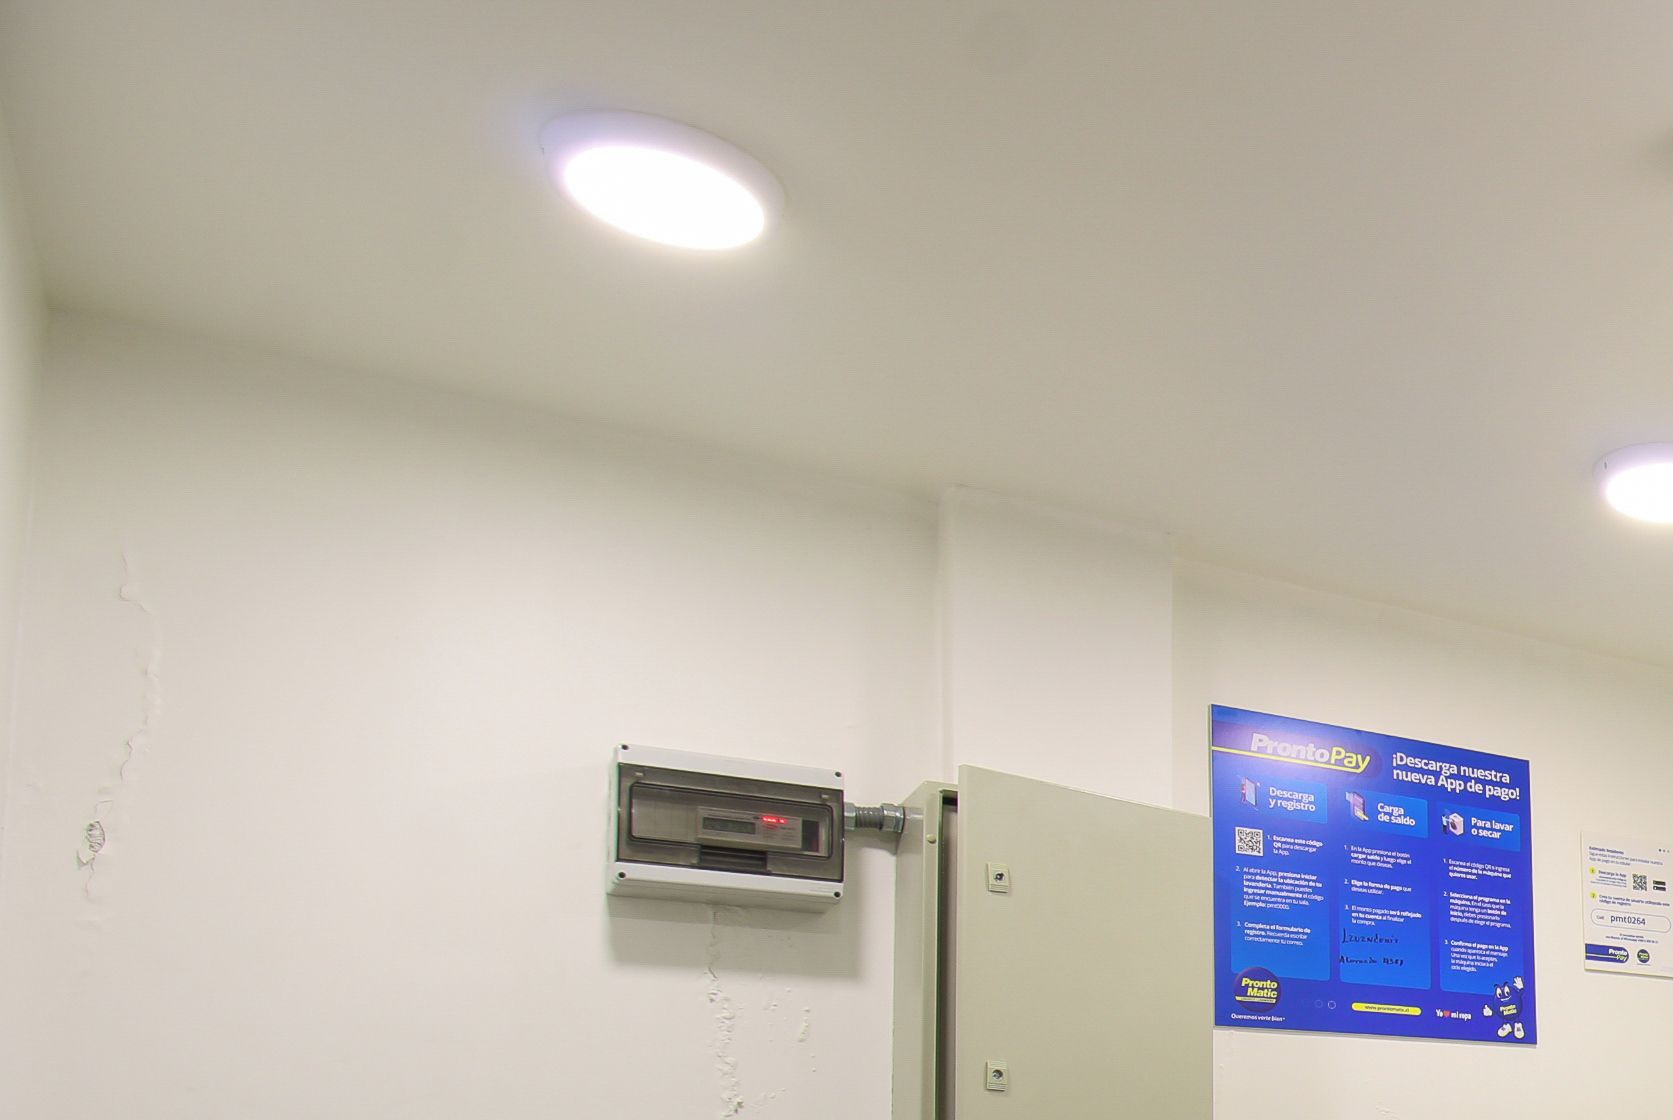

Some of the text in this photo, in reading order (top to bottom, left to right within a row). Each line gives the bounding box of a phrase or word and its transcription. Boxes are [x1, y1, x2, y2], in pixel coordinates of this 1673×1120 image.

[1392, 752, 1510, 784] ¡Descarga nuestra
[1393, 769, 1520, 801] nueva App de pago!
[1269, 786, 1314, 803] Descarga
[1269, 798, 1316, 812] y registro
[1377, 803, 1405, 817] Carga
[1377, 813, 1416, 827] de saldo
[1471, 817, 1514, 832] Para lavar
[1471, 828, 1502, 839] o secar
[1610, 913, 1646, 926] pmt0264
[1608, 948, 1628, 956] Pronto
[1616, 954, 1628, 962] Pay
[1241, 977, 1278, 989] Pronto
[1247, 987, 1278, 998] Matic
[1231, 1013, 1258, 1021] Queremos
[1436, 1009, 1443, 1017] Yo
[1459, 1013, 1472, 1022] ropa
